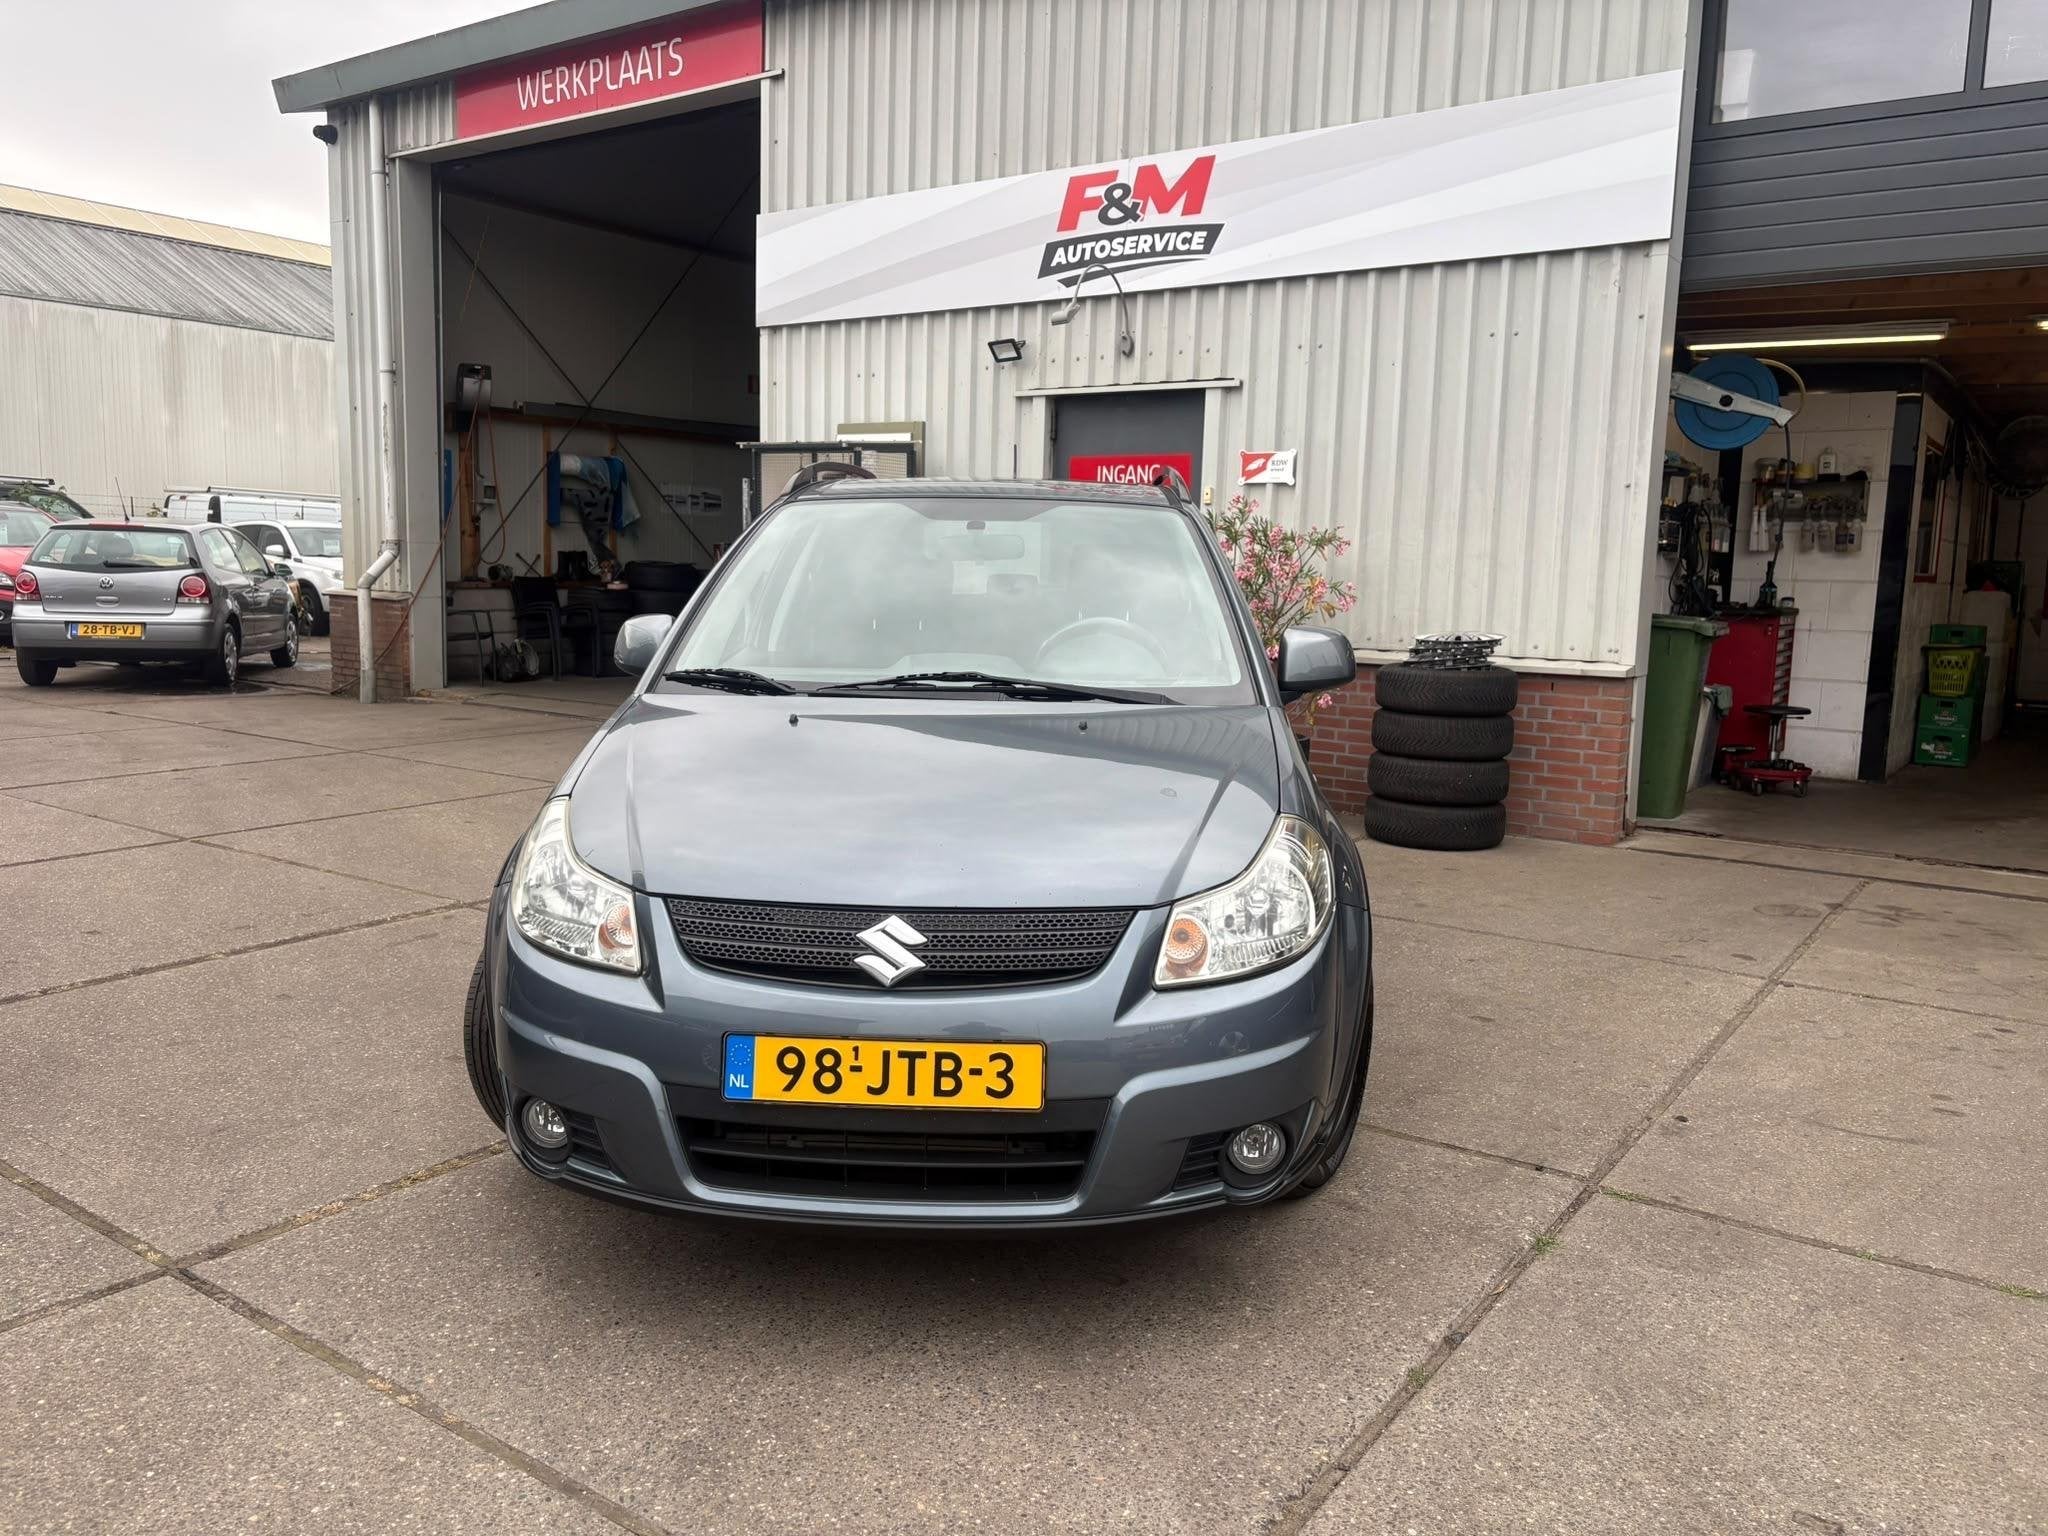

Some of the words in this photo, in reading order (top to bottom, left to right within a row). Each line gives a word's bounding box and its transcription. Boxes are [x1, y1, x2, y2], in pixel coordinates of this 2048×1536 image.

[516, 37, 684, 111] WERKPLAATS
[1057, 155, 1216, 232] F&M
[1050, 231, 1208, 267] AUTOSERVICE
[83, 624, 136, 635] 28-TB-VJ
[729, 1074, 749, 1089] NL
